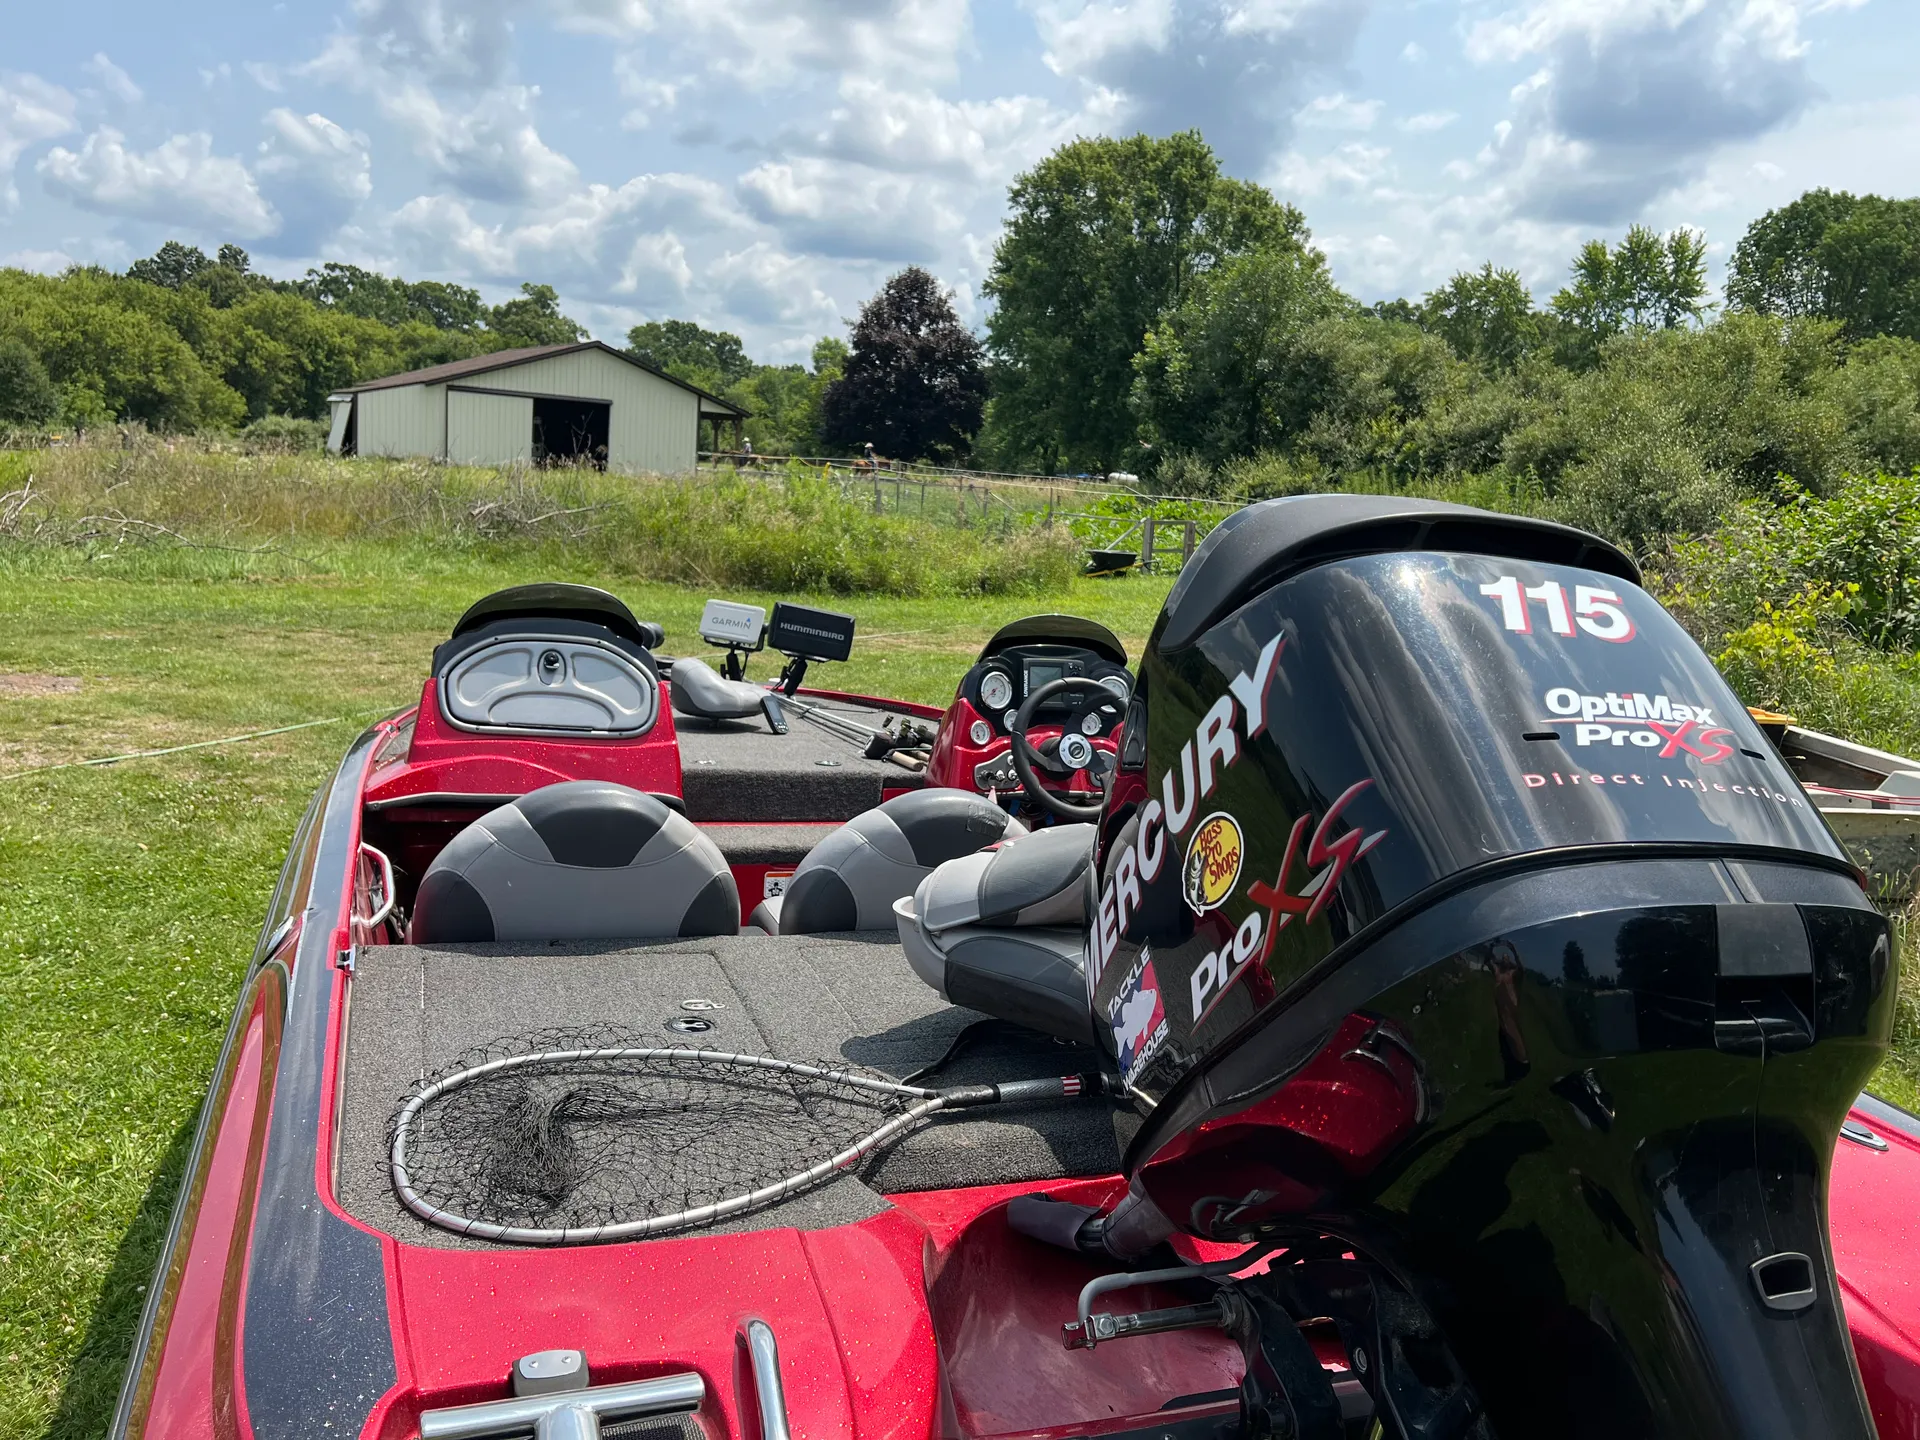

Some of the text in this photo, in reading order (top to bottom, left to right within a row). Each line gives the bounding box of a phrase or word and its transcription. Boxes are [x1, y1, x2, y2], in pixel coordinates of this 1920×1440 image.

[711, 616, 752, 630] GARMIN
[1479, 575, 1637, 643] 115
[780, 622, 845, 641] HUMMINBIRD
[1544, 687, 1718, 728] OptiMax
[1521, 771, 1646, 790] Direct
[1663, 774, 1805, 810] Injection
[1084, 630, 1287, 1012] MERCURY
[1200, 820, 1222, 852] Bass
[1205, 841, 1222, 868] Pro
[1209, 846, 1239, 887] Shops
[1107, 945, 1150, 1020] TACKLE
[1122, 1018, 1169, 1091] WAREHOUSE
